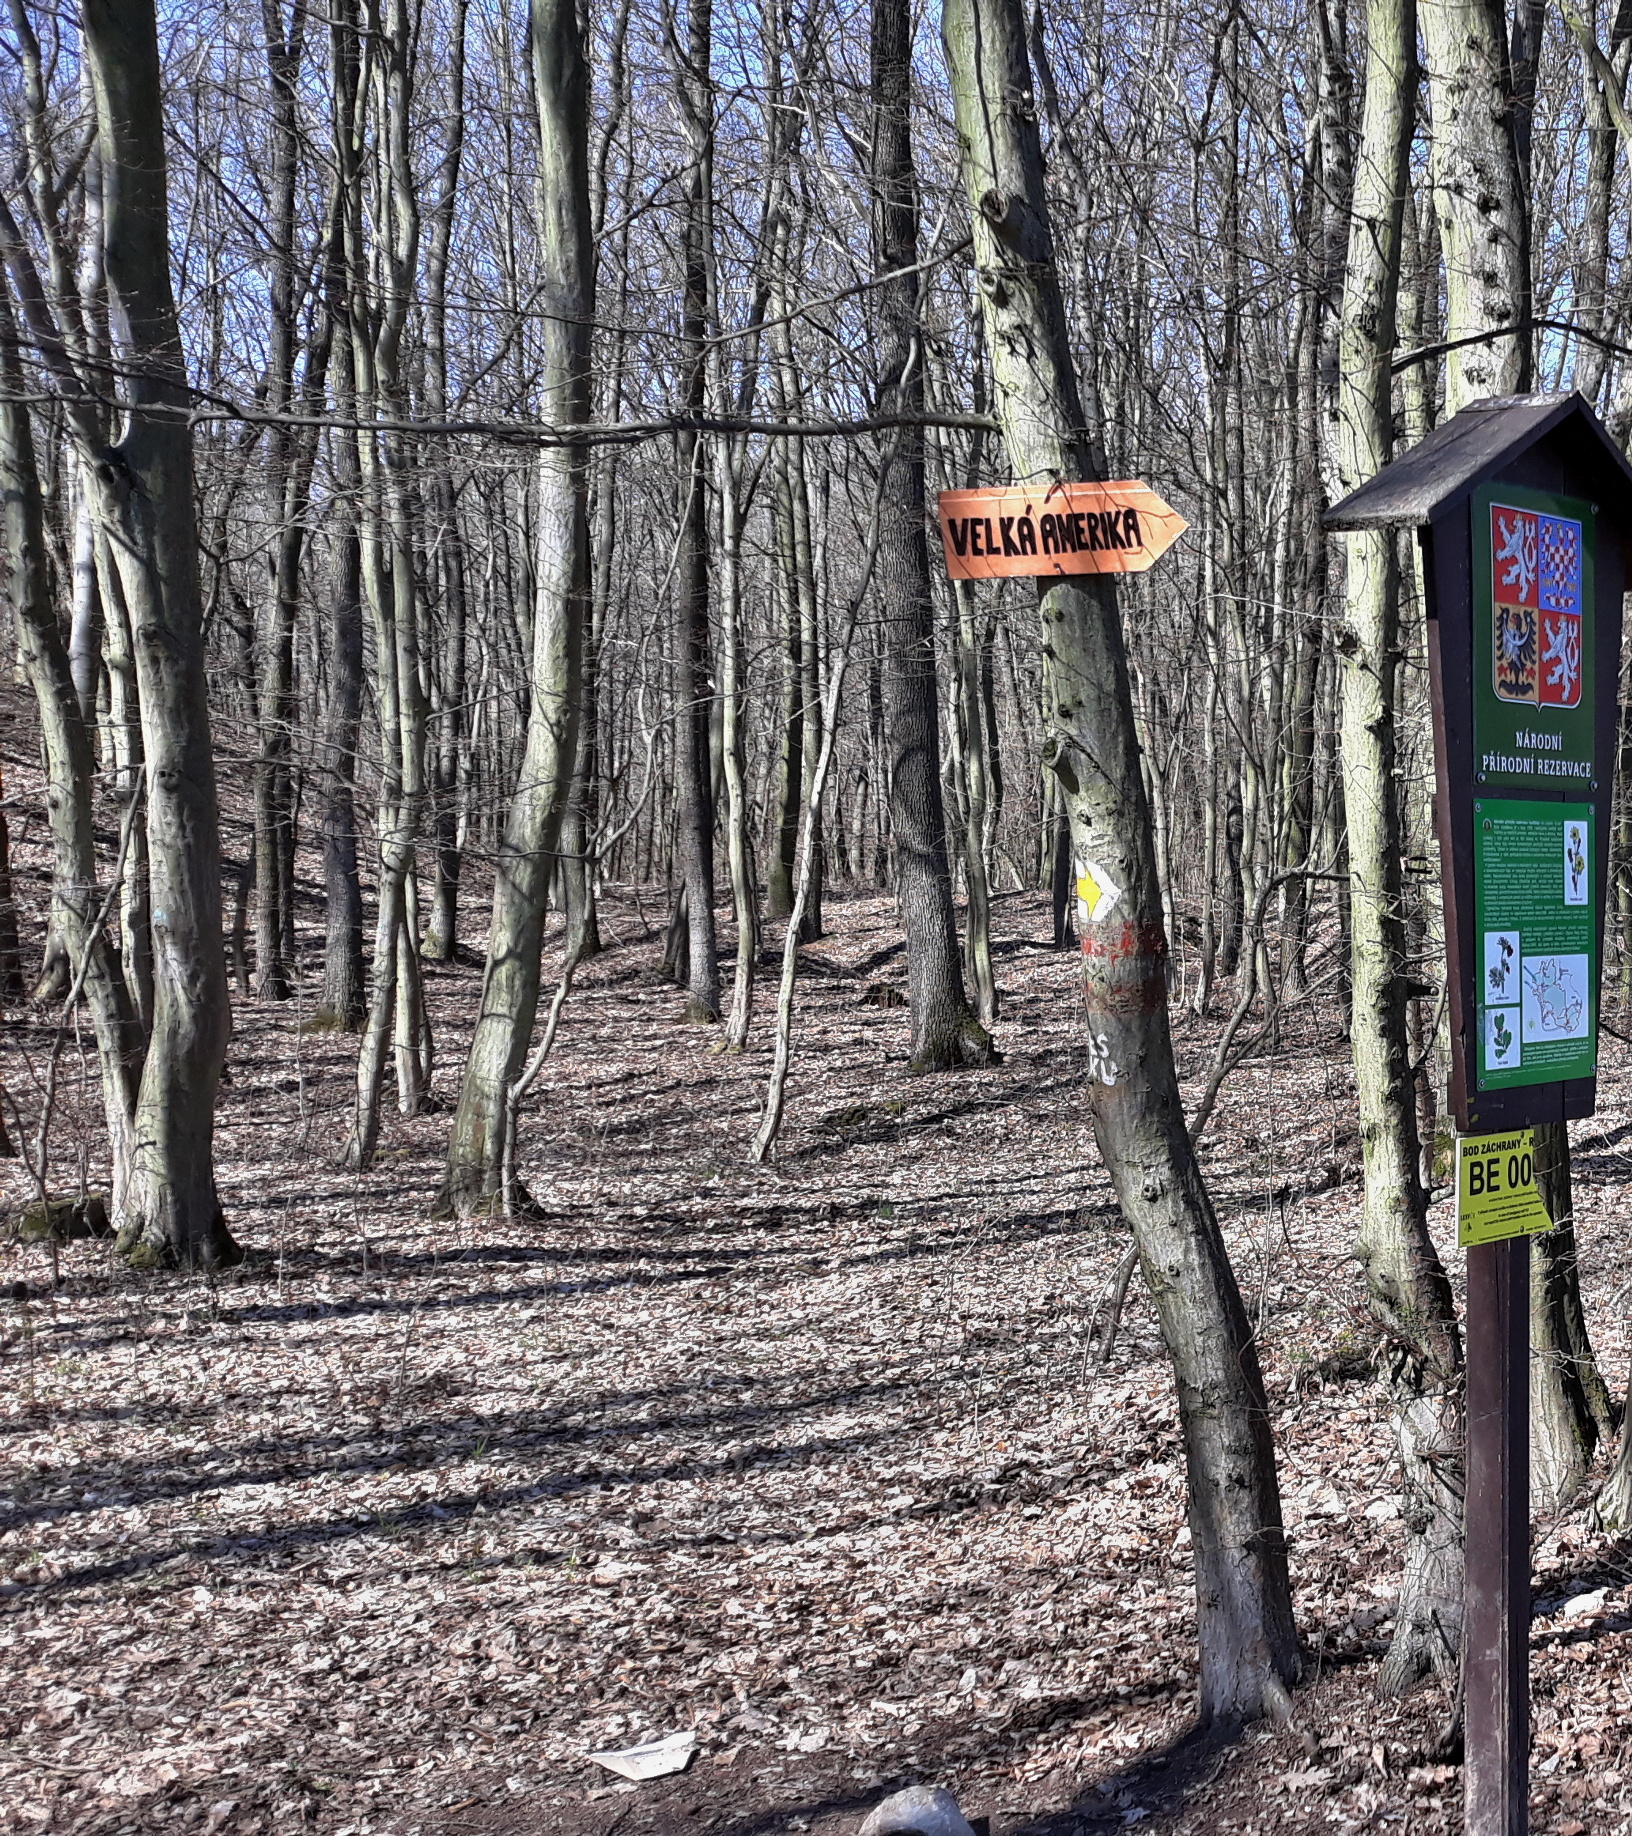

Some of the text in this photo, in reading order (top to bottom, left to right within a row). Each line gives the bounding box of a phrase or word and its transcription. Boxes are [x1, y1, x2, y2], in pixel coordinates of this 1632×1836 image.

[947, 504, 1143, 557] VELKÁ AMERIKA
[1515, 728, 1563, 751] NÁRODNÍ
[1482, 750, 1592, 778] PŘÍRODNÍ REZERVACE
[1462, 1145, 1480, 1158] BOD
[1481, 1140, 1522, 1155] ZÁCHRANY
[1469, 1153, 1532, 1196] BE 00
